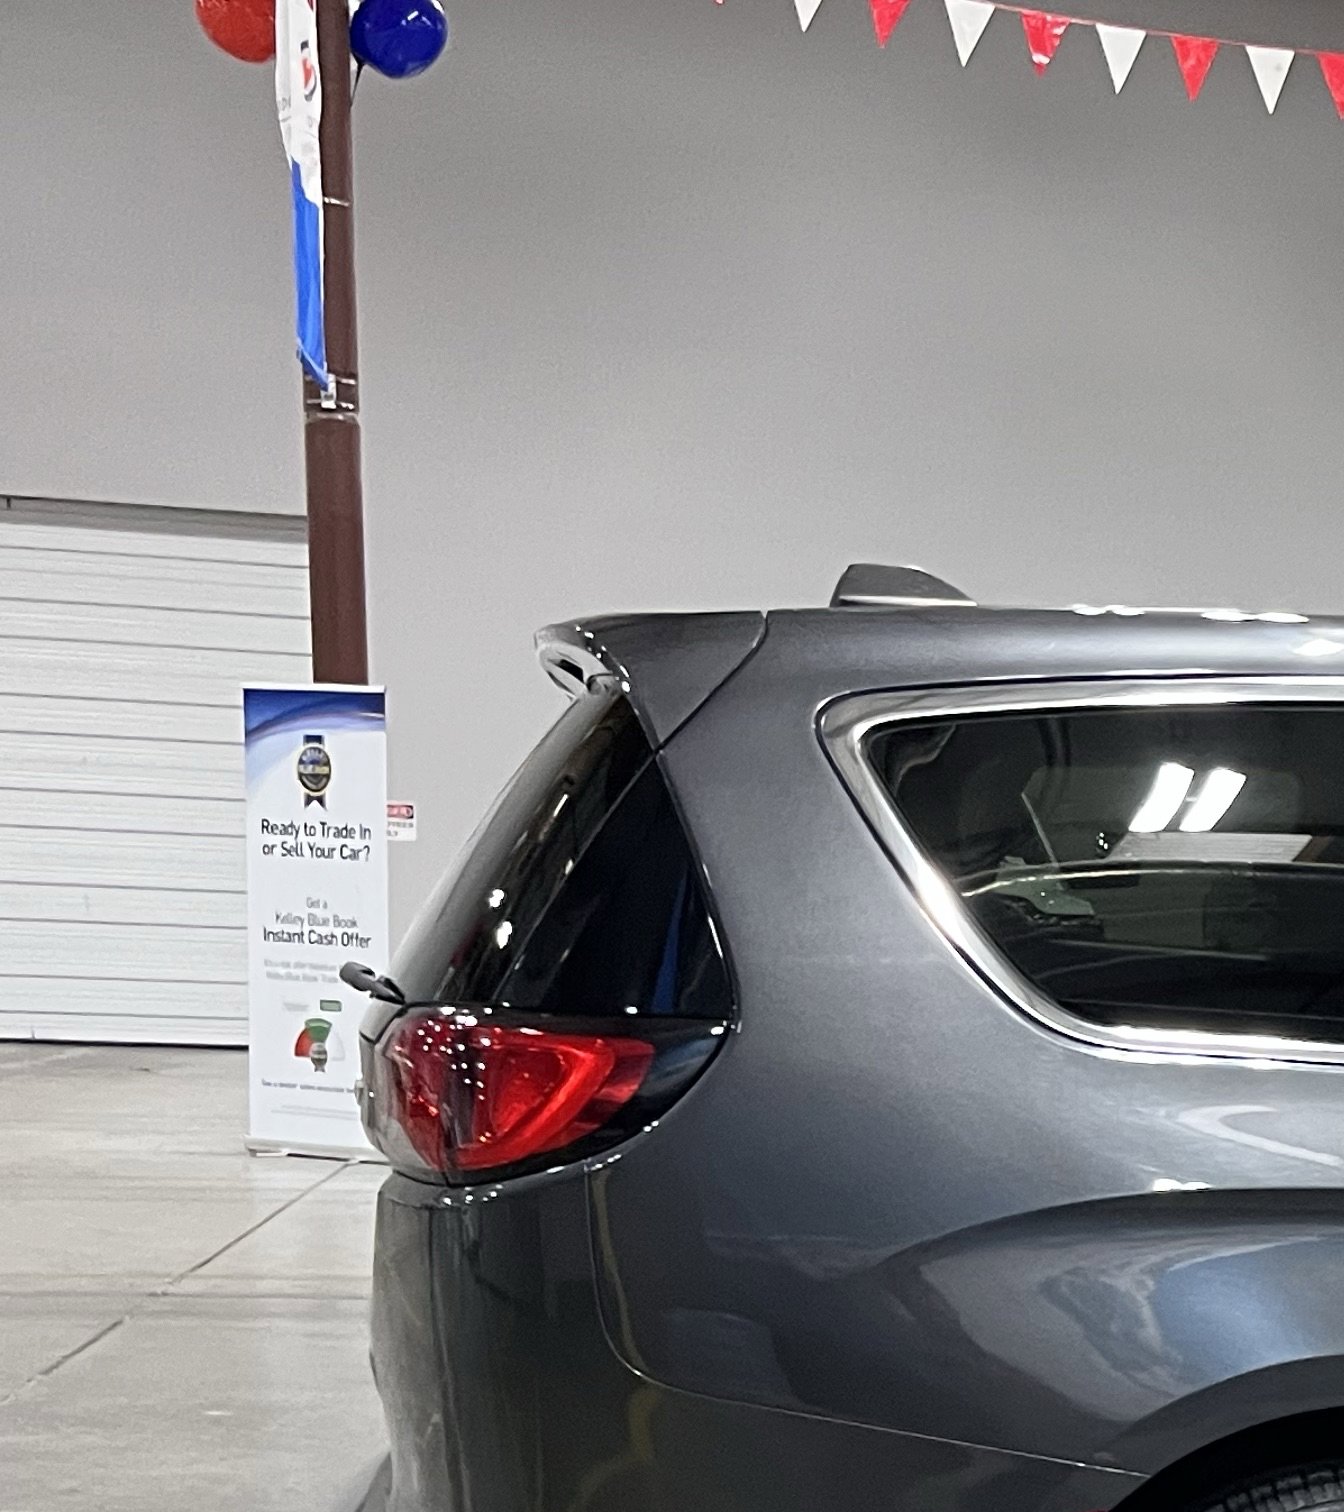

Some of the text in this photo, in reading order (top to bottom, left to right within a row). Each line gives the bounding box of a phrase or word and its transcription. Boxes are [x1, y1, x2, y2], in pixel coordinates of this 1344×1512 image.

[261, 818, 372, 841] Ready to Trade In
[262, 841, 371, 862] or Sell Your Car?
[333, 914, 357, 928] Book
[263, 927, 371, 948] Instant Cash Offer
